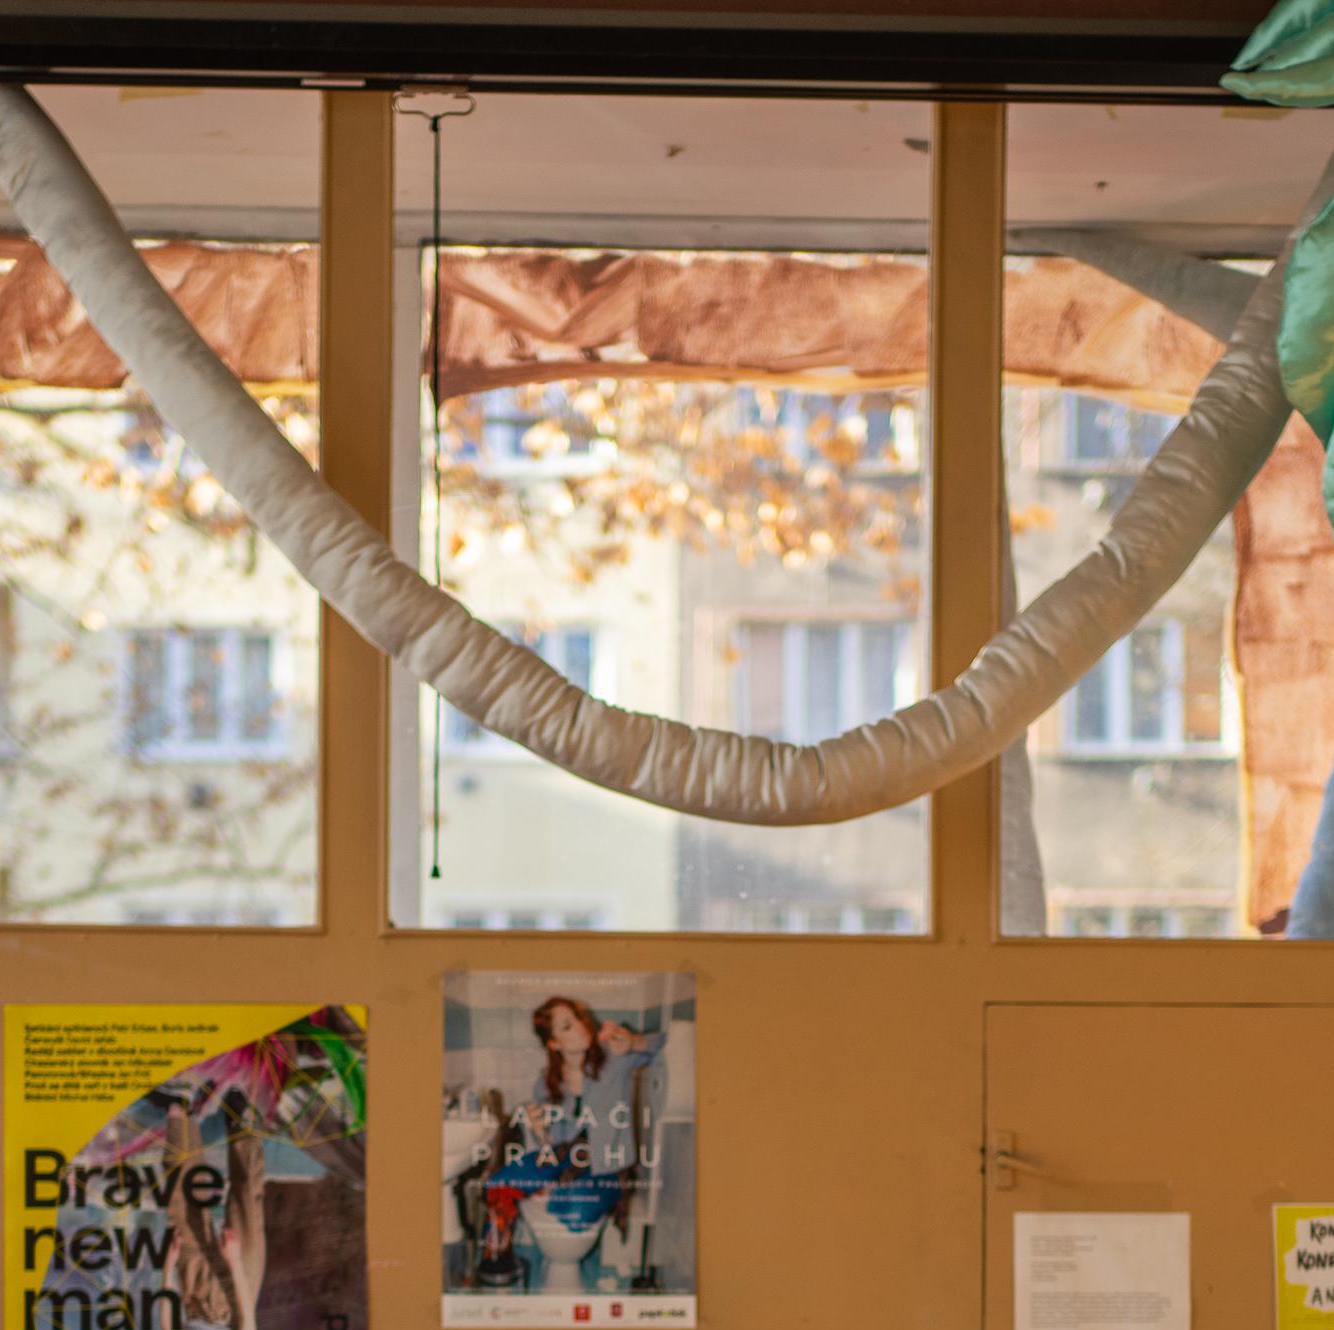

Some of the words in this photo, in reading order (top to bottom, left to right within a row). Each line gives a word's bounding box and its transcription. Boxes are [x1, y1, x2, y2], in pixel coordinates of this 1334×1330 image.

[472, 1143, 662, 1168] PRACHU
[24, 1149, 224, 1208] Brave
[24, 1227, 176, 1271] new
